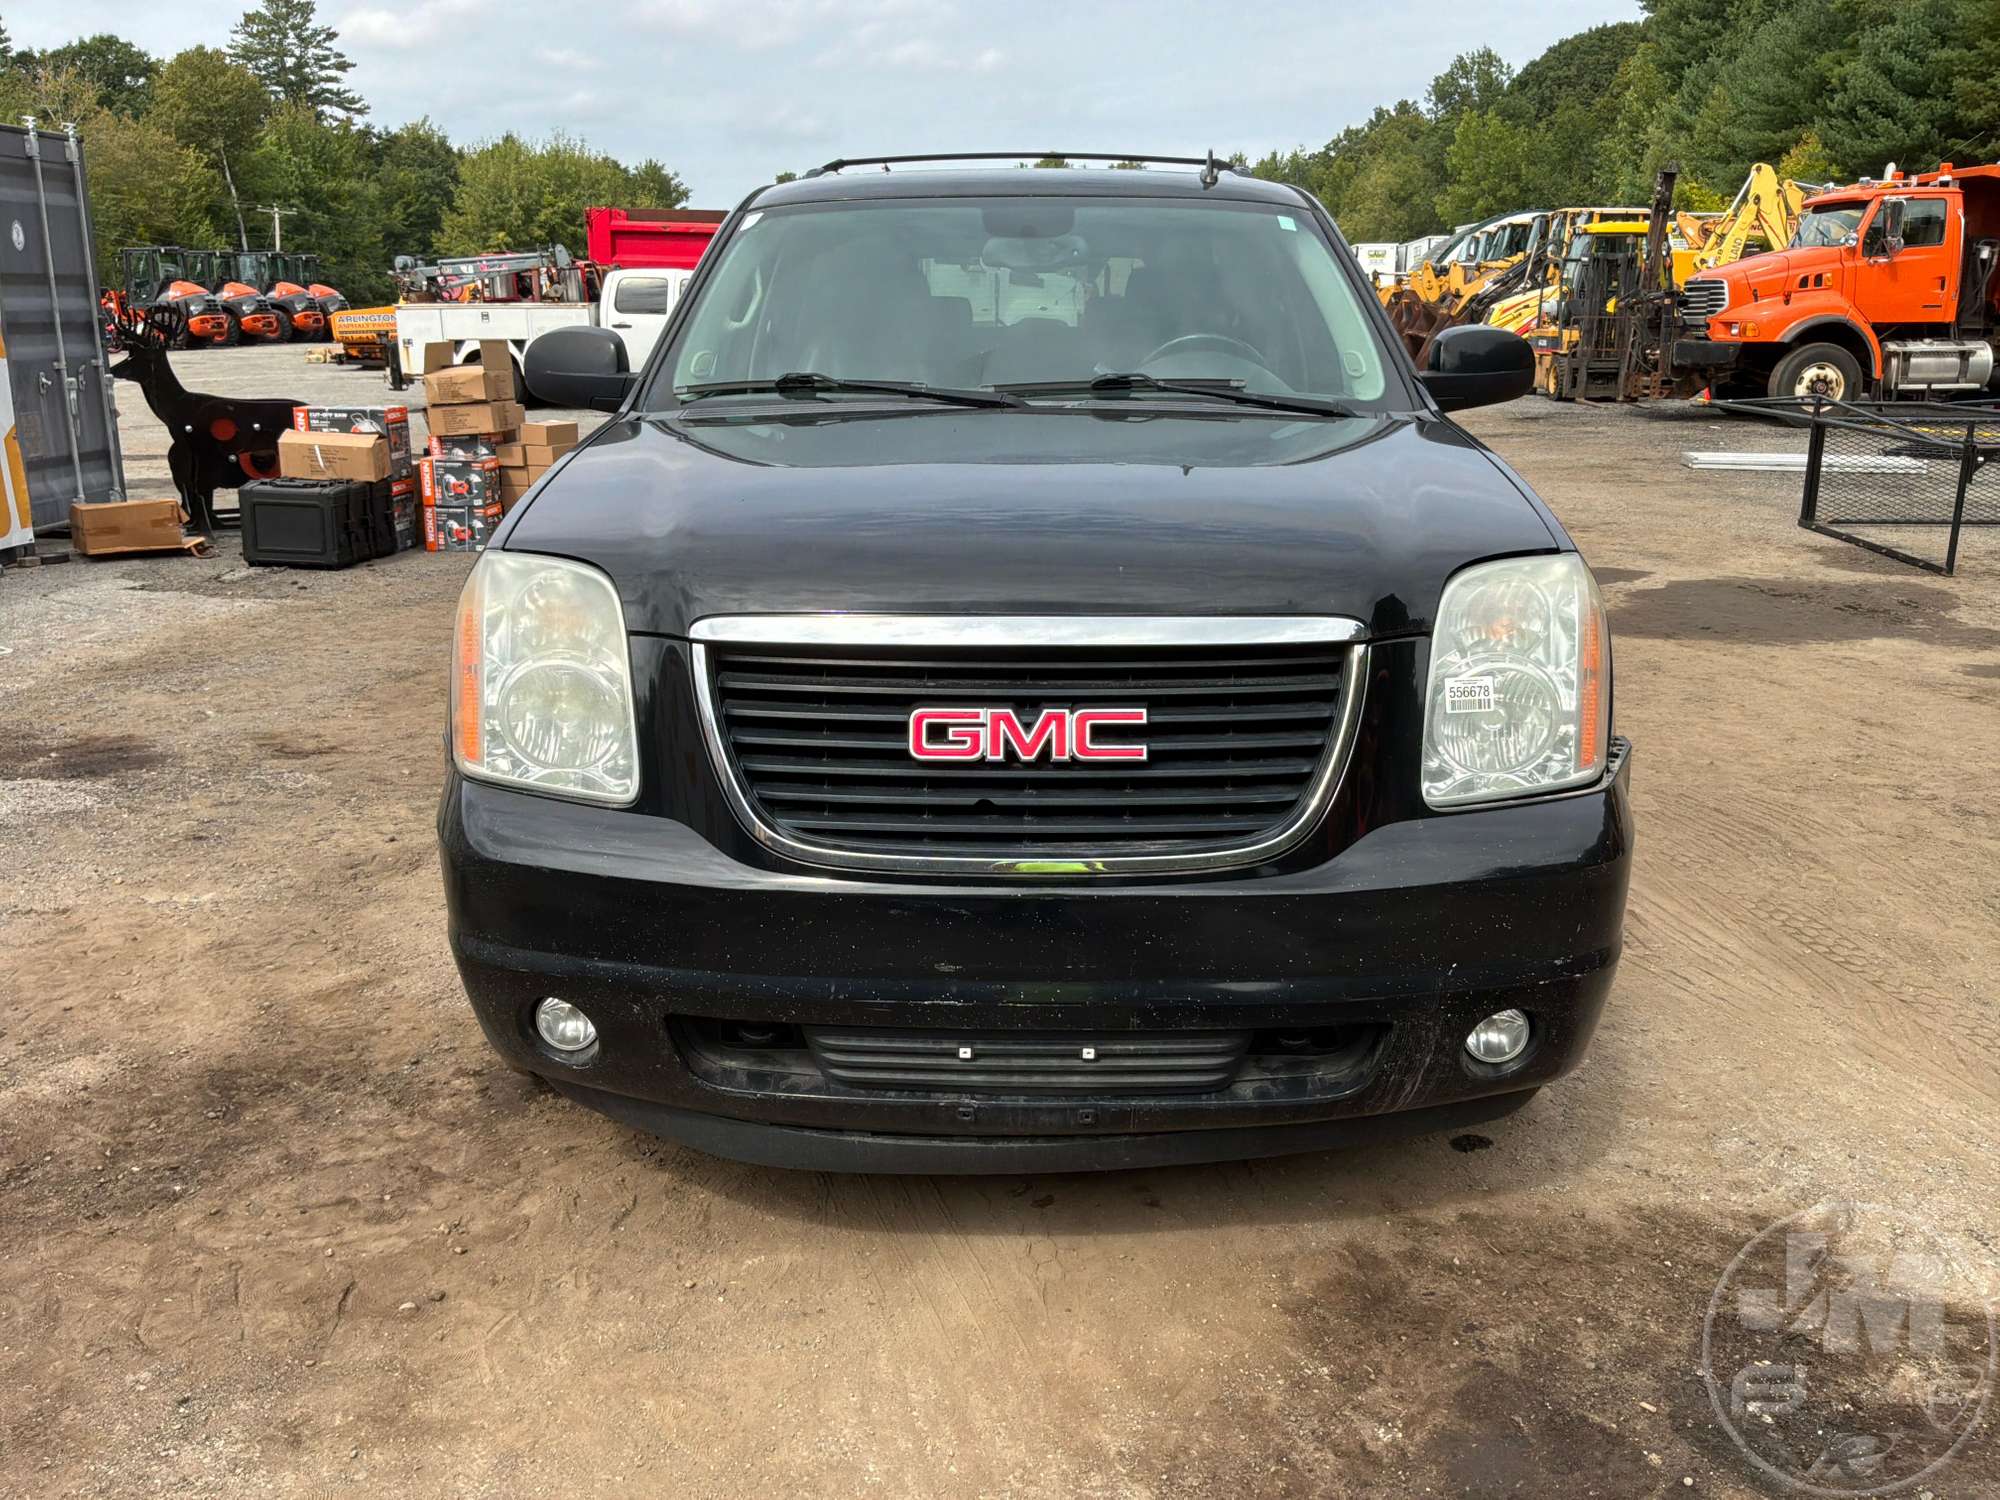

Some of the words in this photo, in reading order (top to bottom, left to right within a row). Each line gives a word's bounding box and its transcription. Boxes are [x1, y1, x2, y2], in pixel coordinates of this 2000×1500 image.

[337, 314, 397, 323] ARLINGTON
[422, 461, 432, 497] WOKIN
[424, 507, 435, 542] WOKIN
[1449, 685, 1490, 699] 556678
[909, 707, 1148, 761] GMC
